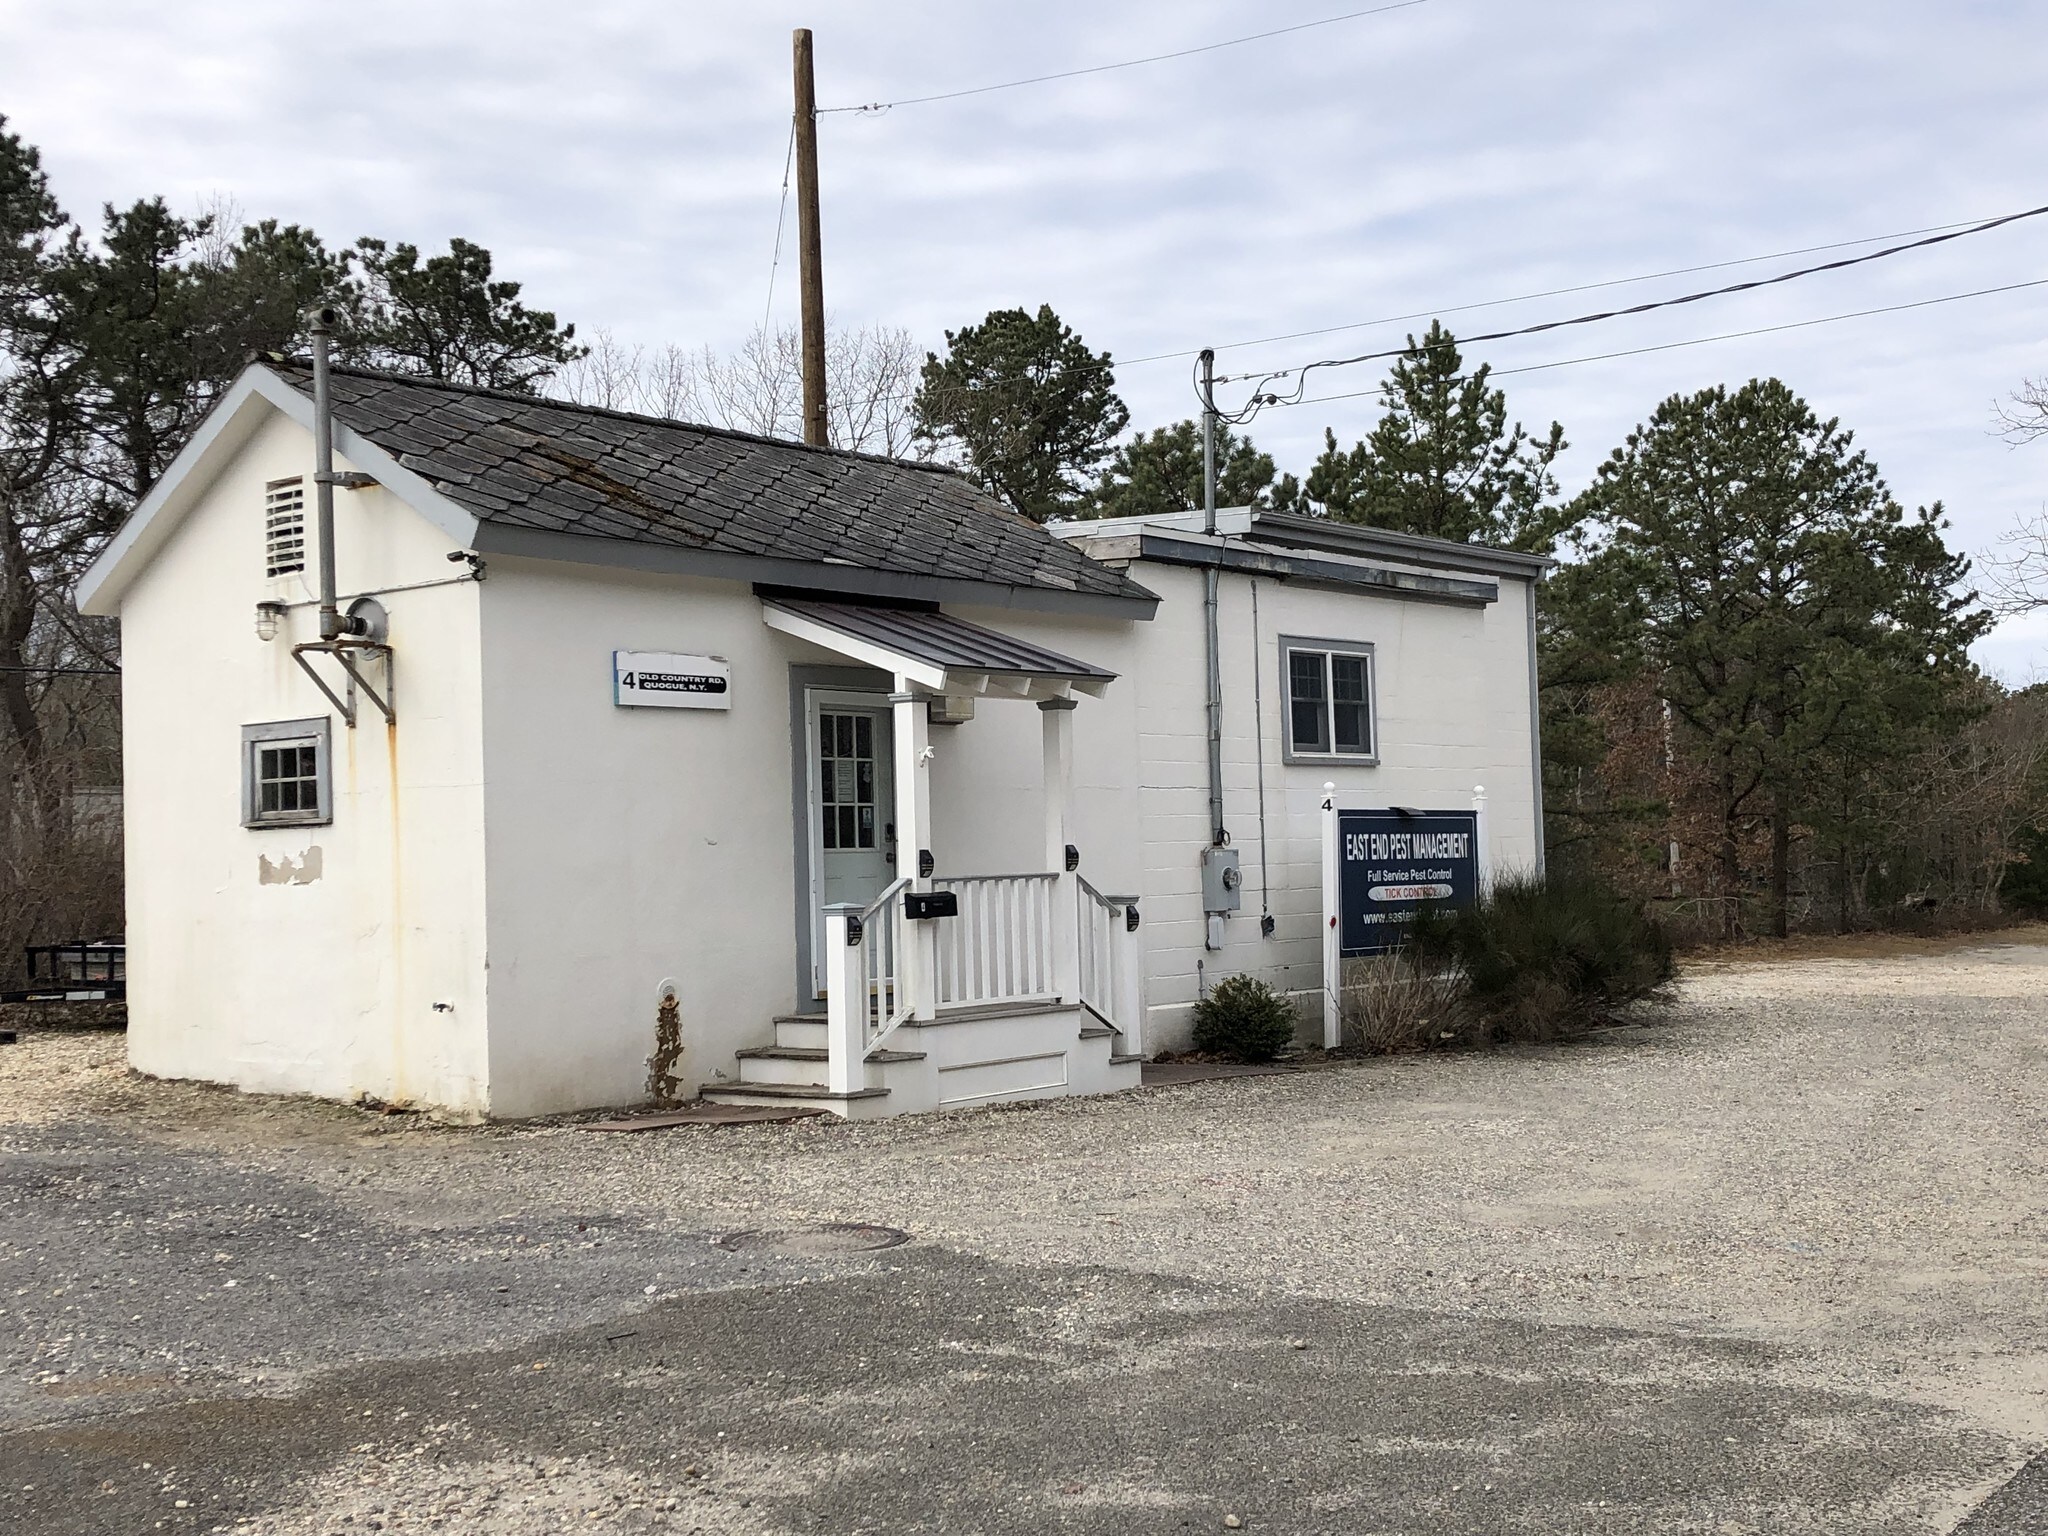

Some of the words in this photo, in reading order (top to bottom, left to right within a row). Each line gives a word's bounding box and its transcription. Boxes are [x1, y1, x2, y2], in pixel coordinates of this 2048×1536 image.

[622, 671, 636, 689] 4
[638, 673, 659, 681] OLD
[660, 674, 707, 683] COUNTRY
[643, 681, 688, 691] QUOGUE,
[1321, 798, 1333, 812] 4
[1346, 833, 1369, 861] EAST
[1370, 833, 1389, 860] END
[1390, 833, 1411, 860] PEST
[1412, 833, 1469, 860] MANAGEMENT
[1367, 869, 1382, 882] Full
[1382, 869, 1410, 881] Service
[1410, 868, 1426, 880] Pest
[1427, 867, 1452, 880] Control
[1384, 888, 1402, 899] TICK
